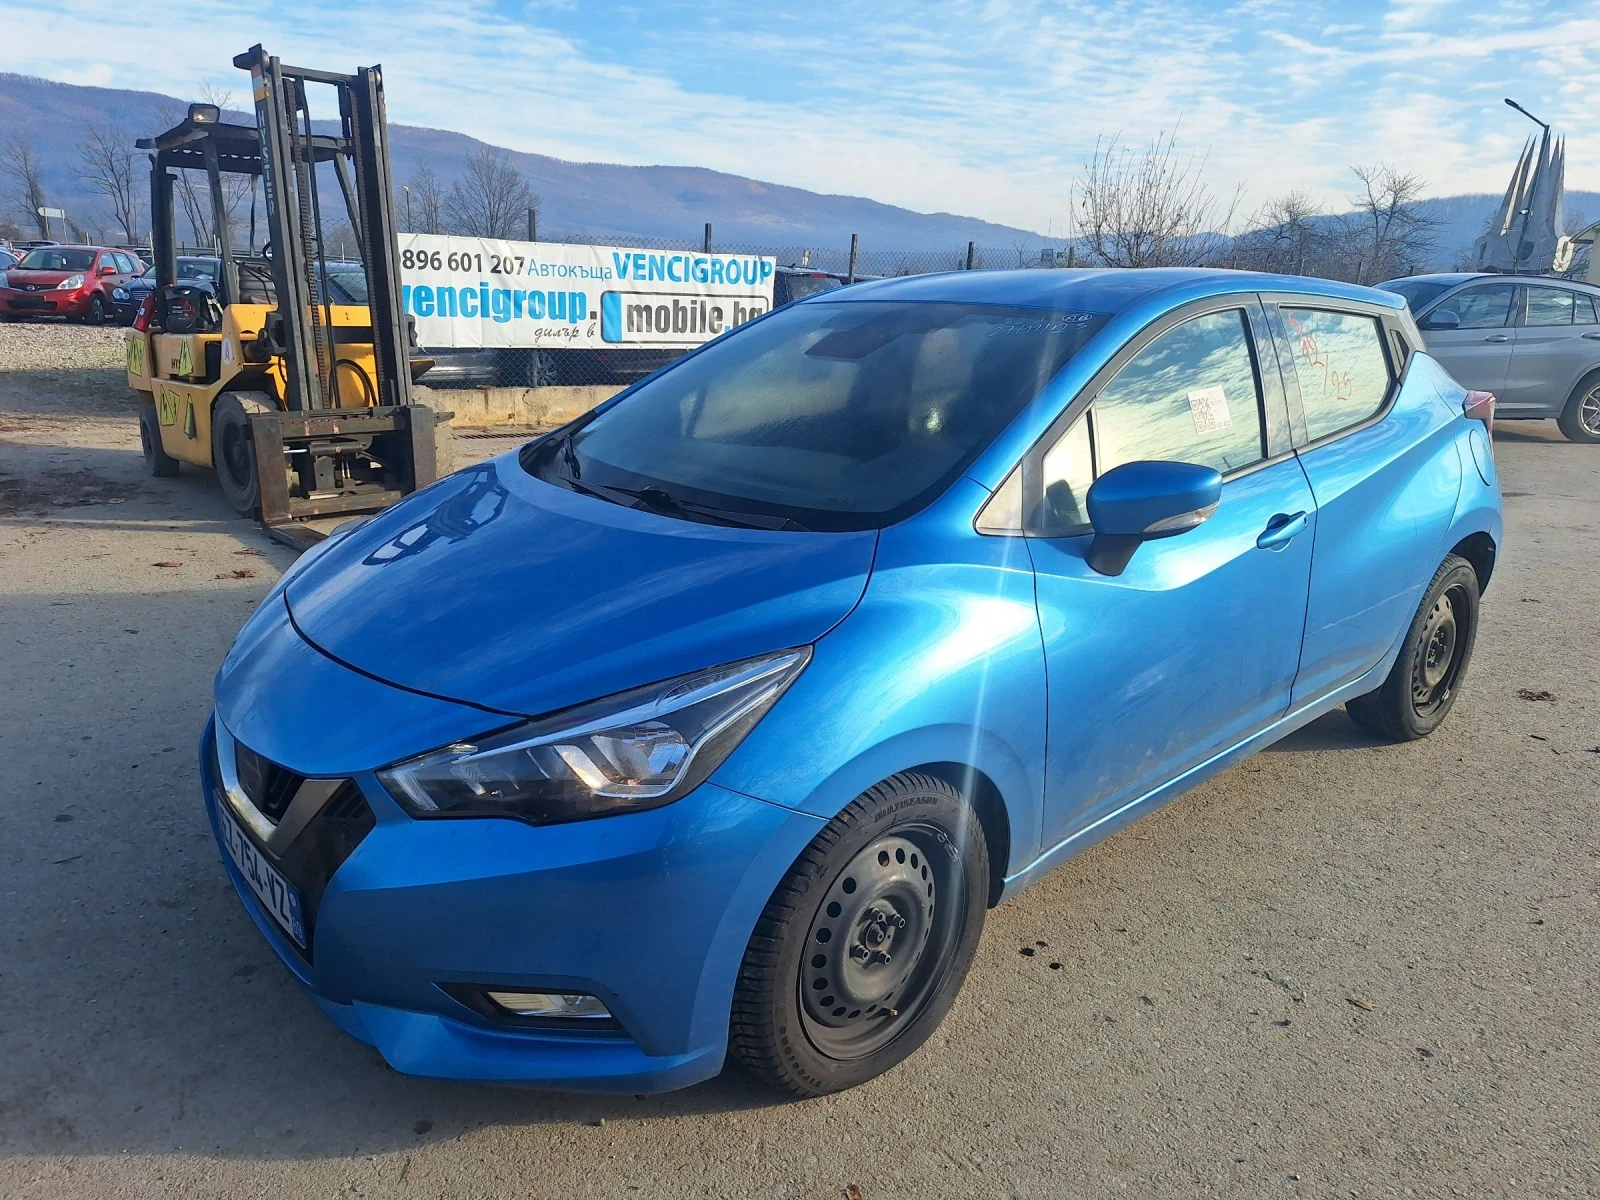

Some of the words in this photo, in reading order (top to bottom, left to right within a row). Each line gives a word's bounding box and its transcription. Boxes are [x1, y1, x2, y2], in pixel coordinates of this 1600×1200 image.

[402, 249, 442, 271] 896
[448, 252, 482, 273] 601
[490, 253, 525, 275] 207
[527, 258, 612, 281] Автокъща
[612, 252, 773, 285] VENCIGROUP
[534, 324, 580, 342] дилър
